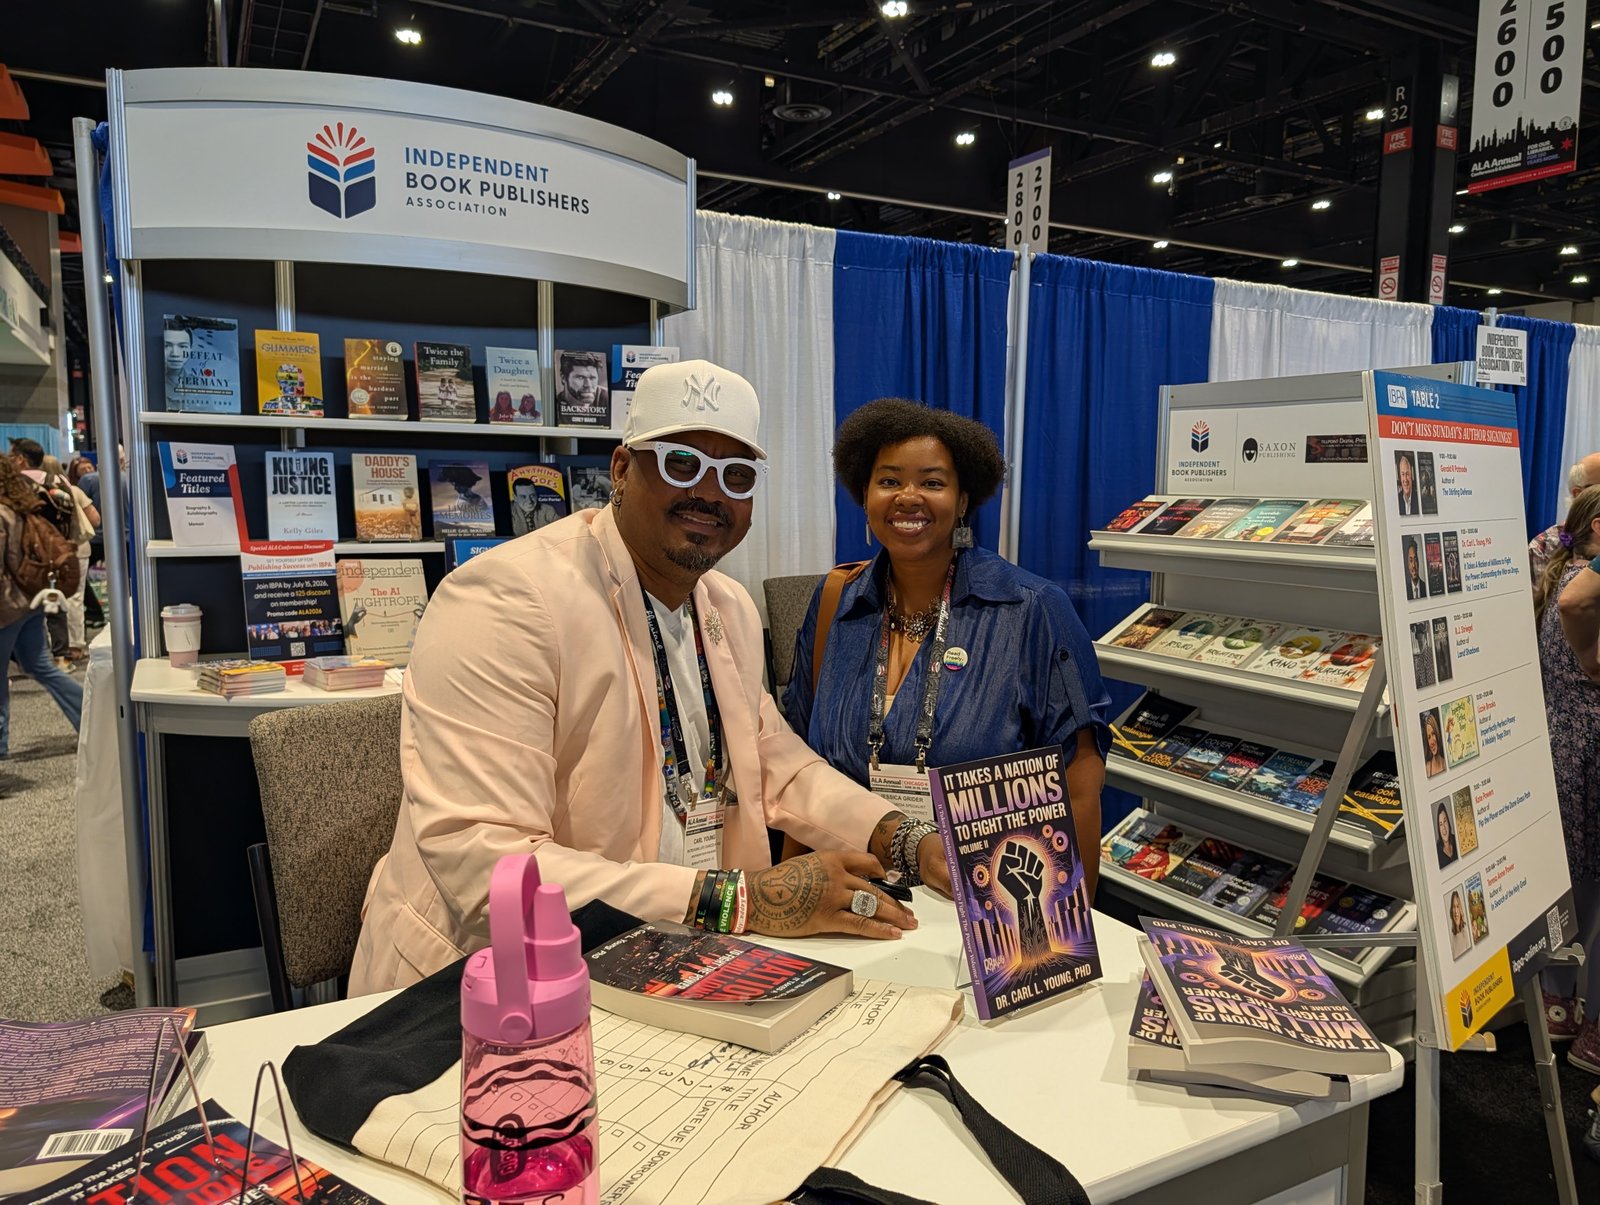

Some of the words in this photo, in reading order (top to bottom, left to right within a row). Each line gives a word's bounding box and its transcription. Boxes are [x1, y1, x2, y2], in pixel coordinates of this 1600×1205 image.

[1396, 86, 1405, 102] R
[1390, 105, 1408, 123] 32
[1391, 131, 1406, 141] FIRE
[1389, 140, 1407, 150] HOSE
[405, 147, 549, 183] INDEPENDENT
[1471, 161, 1490, 172] ALA
[1491, 153, 1522, 168] Annual
[406, 172, 472, 195] BOOK
[480, 181, 590, 215] PUBLISHERS
[406, 197, 507, 217] ASSOCIATION
[1014, 172, 1023, 245] 2800
[1032, 166, 1042, 240] 2700
[1487, 333, 1519, 348] INDEPENDENT
[183, 350, 223, 361] DEFEAT
[261, 343, 317, 354] GLIMMERS
[424, 346, 449, 357] Twice
[451, 347, 464, 357] the
[1482, 345, 1494, 358] BOOK
[1495, 347, 1523, 361] PUBLISHERS
[373, 355, 399, 363] staying
[430, 357, 459, 367] Family
[498, 356, 524, 366] Twice
[1478, 357, 1510, 372] ASSOCIATION
[493, 366, 533, 377] Daughter
[178, 377, 230, 388] GERMANY
[1390, 388, 1406, 406] IBPA
[1411, 391, 1434, 408] TABLE
[1435, 395, 1440, 408] 2
[560, 405, 607, 414] BACKSTORY
[1391, 421, 1414, 436] DON'T
[1415, 423, 1432, 438] MISS
[1432, 425, 1462, 440] SUNDAY'S
[1463, 428, 1487, 441] AUTHOR
[1487, 431, 1512, 444] SIGNINGS!
[1259, 442, 1296, 451] SAXON
[365, 456, 410, 467] DADDY'S
[179, 473, 225, 484] Featured
[371, 468, 406, 479] HOUSE
[511, 468, 560, 481] ANYTHING
[181, 484, 210, 494] Titles
[272, 476, 331, 495] JUSTICE
[530, 475, 559, 489] GOES
[283, 527, 302, 535] Kelly
[248, 563, 281, 571] Publishing
[282, 563, 305, 571] Success
[341, 561, 424, 579] independent
[283, 582, 291, 590] by
[292, 581, 304, 589] July
[371, 588, 388, 596] The
[306, 589, 331, 597] discount
[279, 599, 317, 608] membership!
[353, 596, 420, 607] TIGHTROPE
[298, 608, 322, 616] ALA2026
[1267, 658, 1297, 669] KANO
[1312, 665, 1357, 677] MURASAKI
[944, 773, 954, 791] IT
[955, 766, 992, 789] TAKES
[994, 765, 1002, 780] A
[1004, 757, 1043, 778] NATION
[1045, 753, 1059, 770] OF
[947, 772, 1063, 825] MILLIONS
[1354, 790, 1400, 806] catalogue
[955, 825, 970, 842] TO
[972, 816, 1004, 839] FIGHT
[1006, 811, 1027, 830] THE
[1028, 802, 1067, 827] POWER
[959, 841, 982, 855] VOLUME
[983, 840, 989, 849] II
[721, 885, 735, 927] VIOLENCE
[1152, 920, 1177, 929] PHD
[1180, 925, 1220, 938] YOUNG,
[1236, 937, 1264, 946] CARL
[1512, 937, 1546, 973] ibpa-online.org
[677, 972, 702, 990] POWER
[996, 996, 1011, 1010] DR.
[1011, 986, 1033, 1006] CARL
[1034, 984, 1042, 996] L.
[1042, 973, 1074, 992] YOUNG,
[1075, 963, 1092, 982] PHD
[849, 991, 877, 1009] TITLE
[1181, 987, 1239, 1003] POWER
[865, 989, 896, 1026] AUTHOR
[1244, 995, 1275, 1011] THE
[1187, 995, 1372, 1039] MILLIONS
[1194, 1011, 1217, 1022] OF
[1281, 1006, 1328, 1020] FIGHT
[1332, 1011, 1356, 1021] TO
[1221, 1013, 1282, 1035] NATION
[1135, 1030, 1157, 1040] OF
[1285, 1029, 1297, 1040] A
[1304, 1033, 1358, 1049] TAKES
[1362, 1039, 1380, 1050] IT
[659, 1069, 673, 1077] 3
[678, 1076, 693, 1087] 2
[724, 1087, 758, 1111] TITLE
[690, 1100, 716, 1124] DATE
[736, 1091, 782, 1131] AUTHOR
[671, 1124, 696, 1143] DUE
[83, 1170, 106, 1184] The
[108, 1156, 134, 1171] War
[153, 1131, 186, 1149] Drugs
[70, 1191, 85, 1202] IT
[86, 1168, 136, 1194] TAKES
[139, 1162, 151, 1171] A
